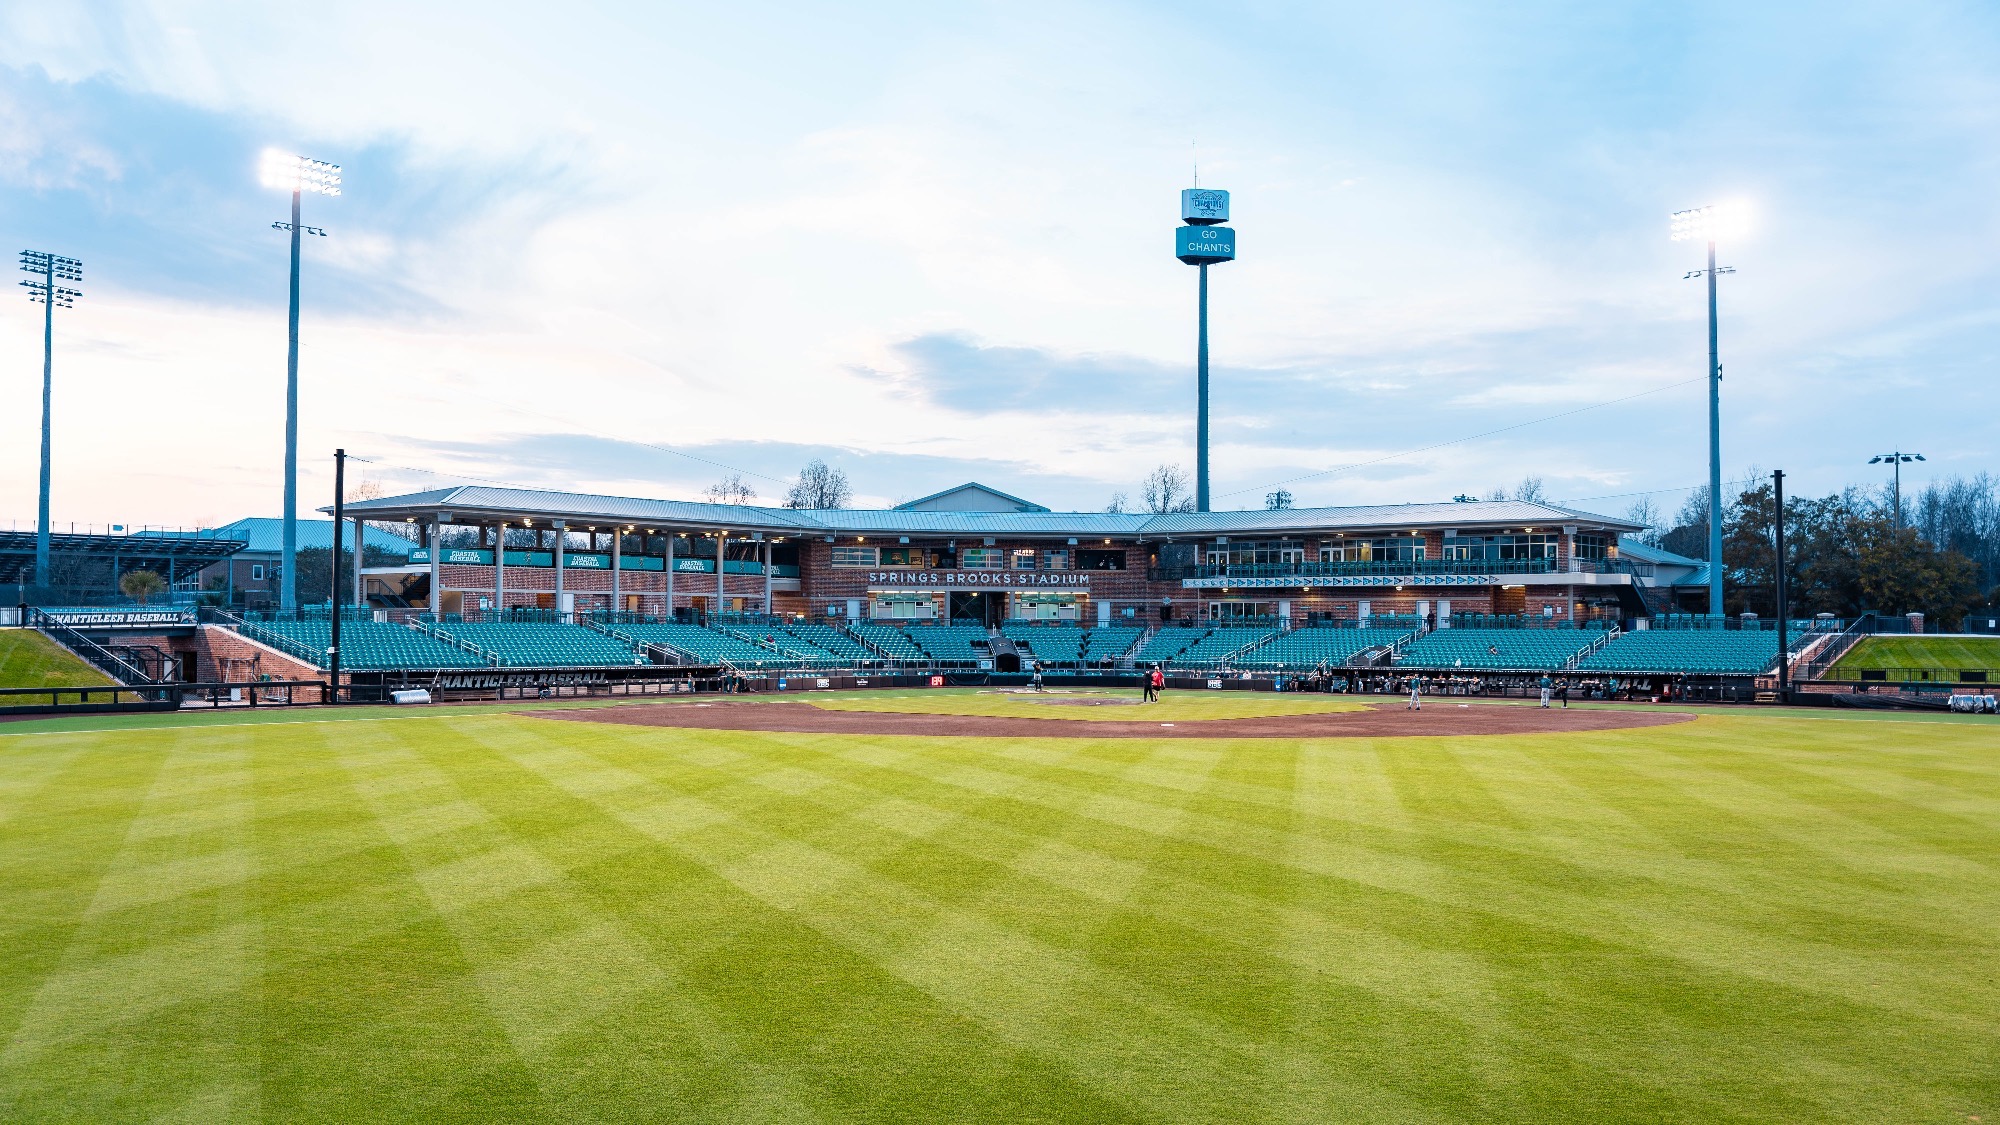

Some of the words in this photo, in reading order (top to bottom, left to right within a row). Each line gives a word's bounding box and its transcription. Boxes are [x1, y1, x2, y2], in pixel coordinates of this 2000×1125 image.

[1201, 230, 1217, 239] GO
[1188, 242, 1231, 253] CHANTS
[868, 572, 938, 583] SPRINGS
[946, 573, 1011, 583] BROOKS
[1018, 574, 1089, 584] STADIUM
[126, 613, 179, 622] BASEBALL
[438, 674, 535, 688] HANTICLEER
